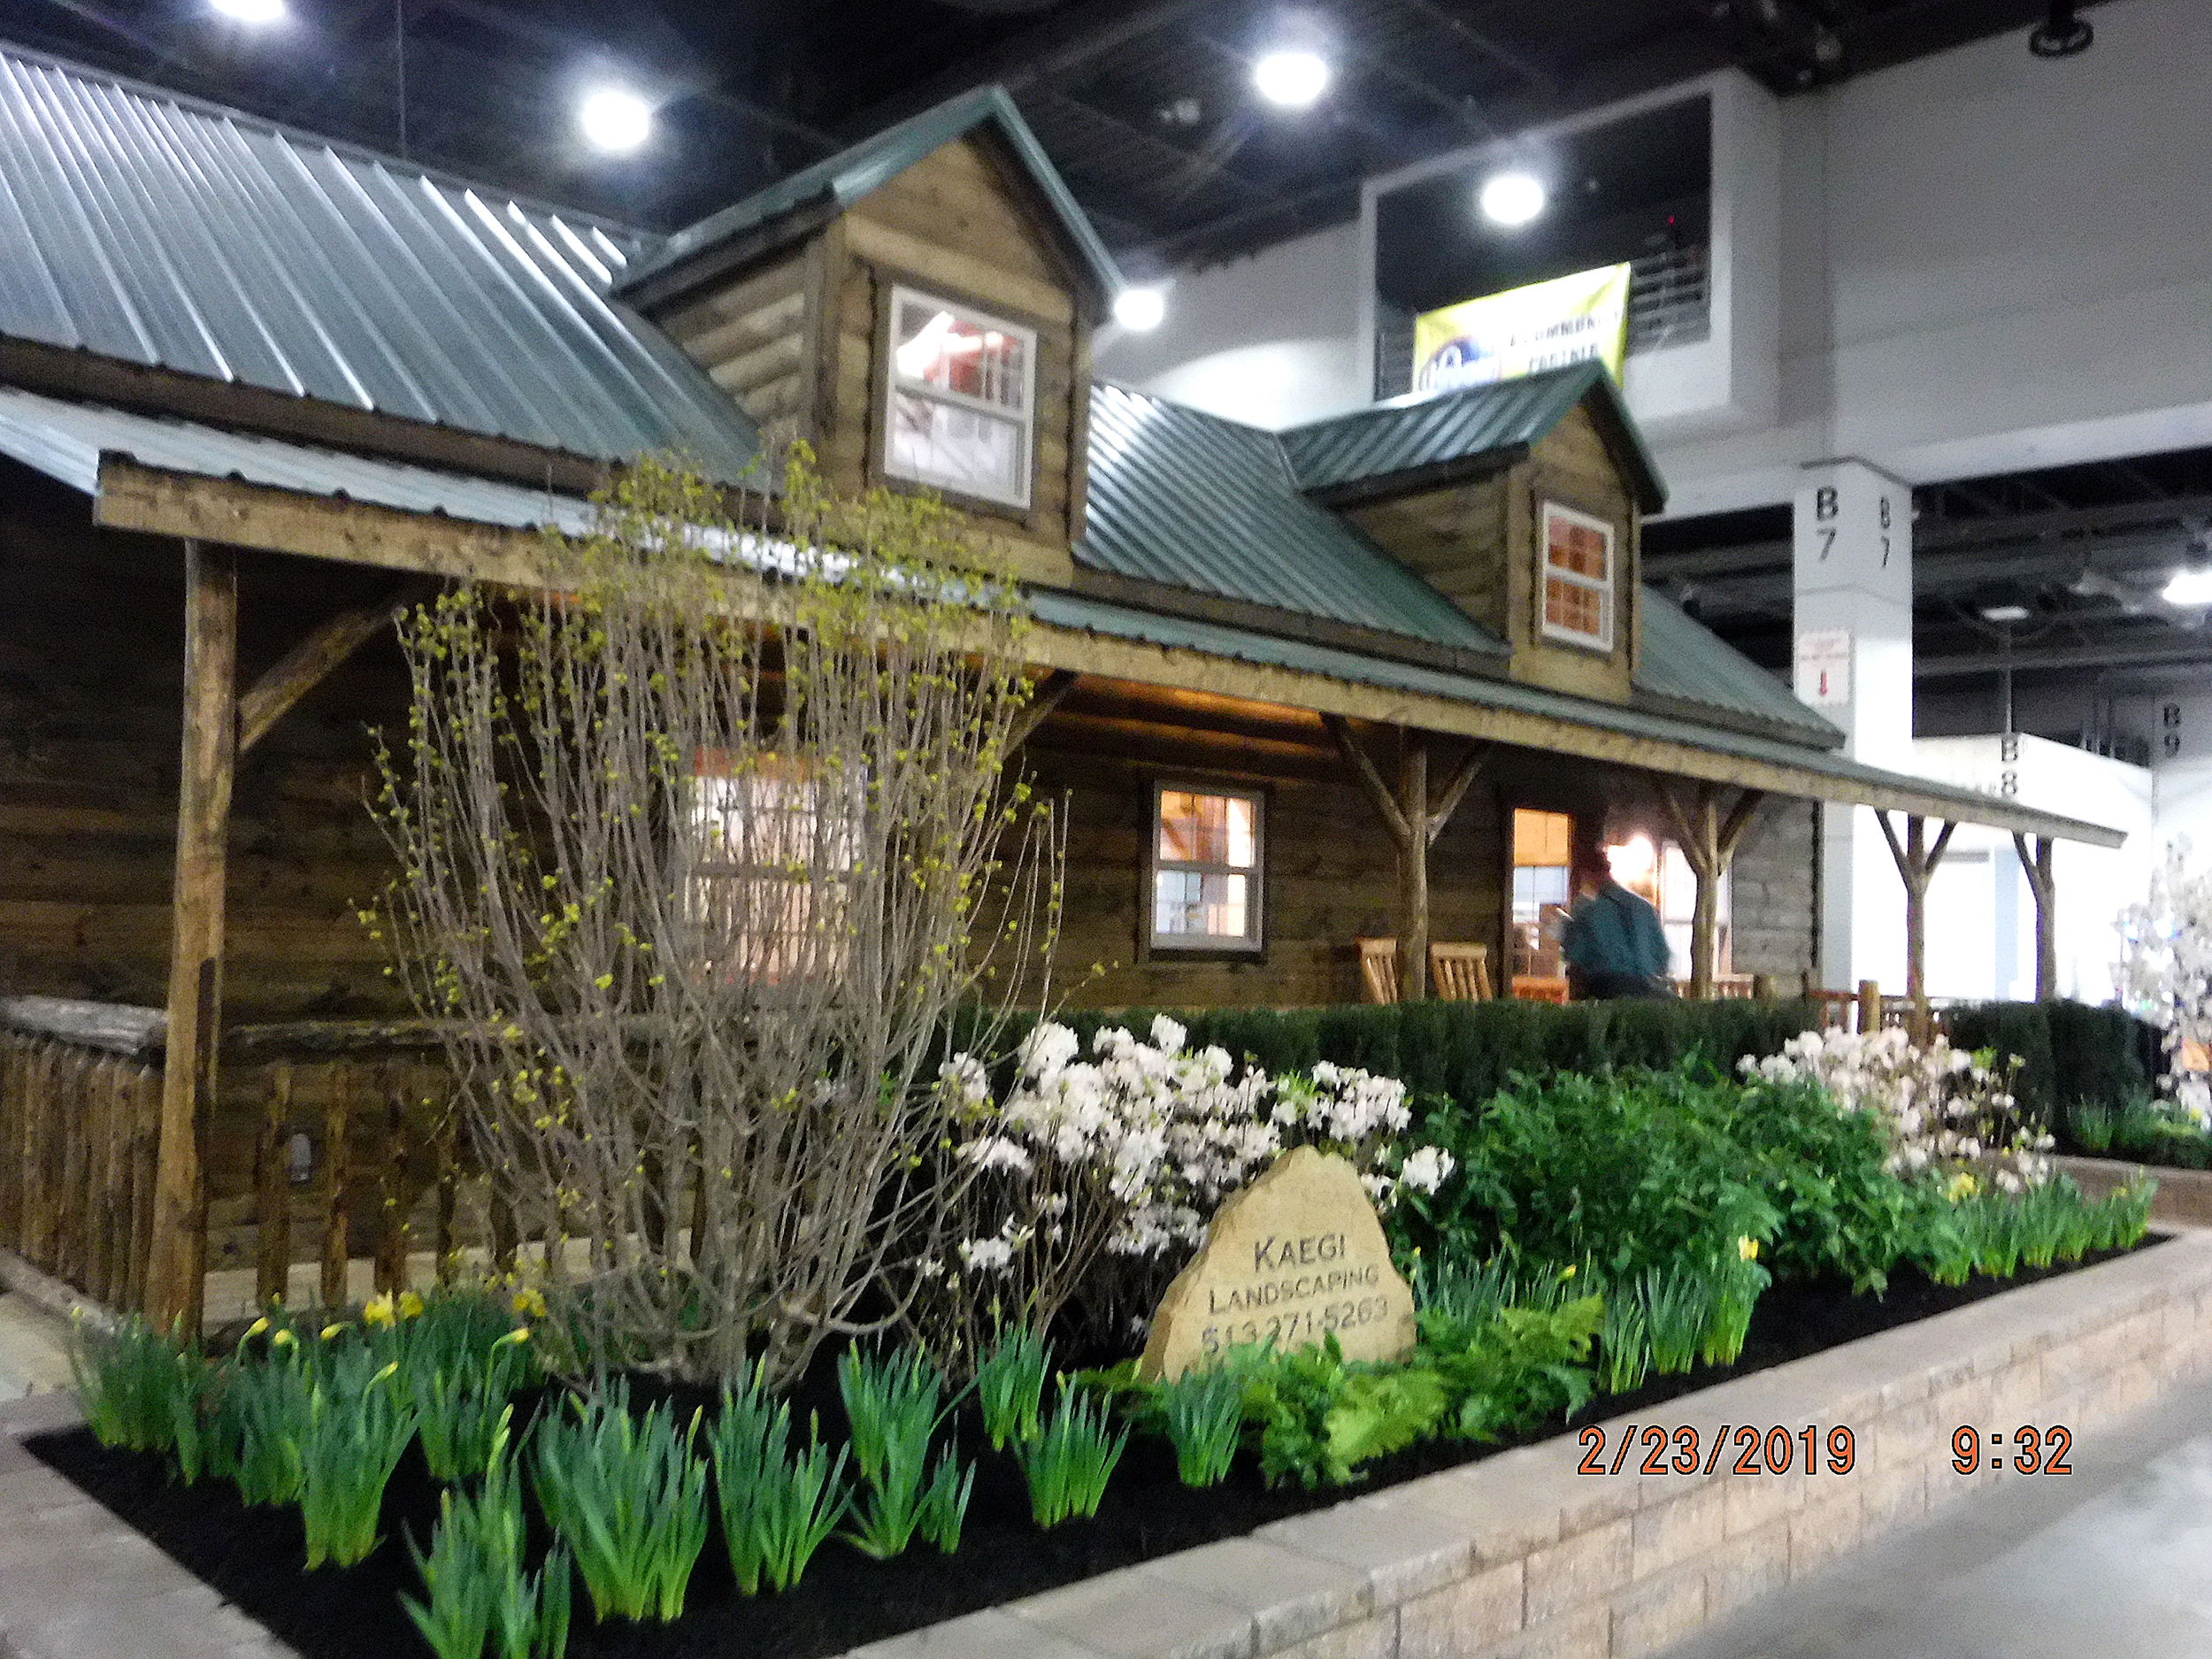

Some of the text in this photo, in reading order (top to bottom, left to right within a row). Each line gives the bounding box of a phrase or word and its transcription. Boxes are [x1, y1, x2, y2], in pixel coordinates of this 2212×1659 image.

[1816, 487, 1839, 521] B
[1816, 528, 1837, 562] 7
[1254, 1233, 1346, 1273] KAEGI
[1209, 1263, 1379, 1316] LANDSCAPING
